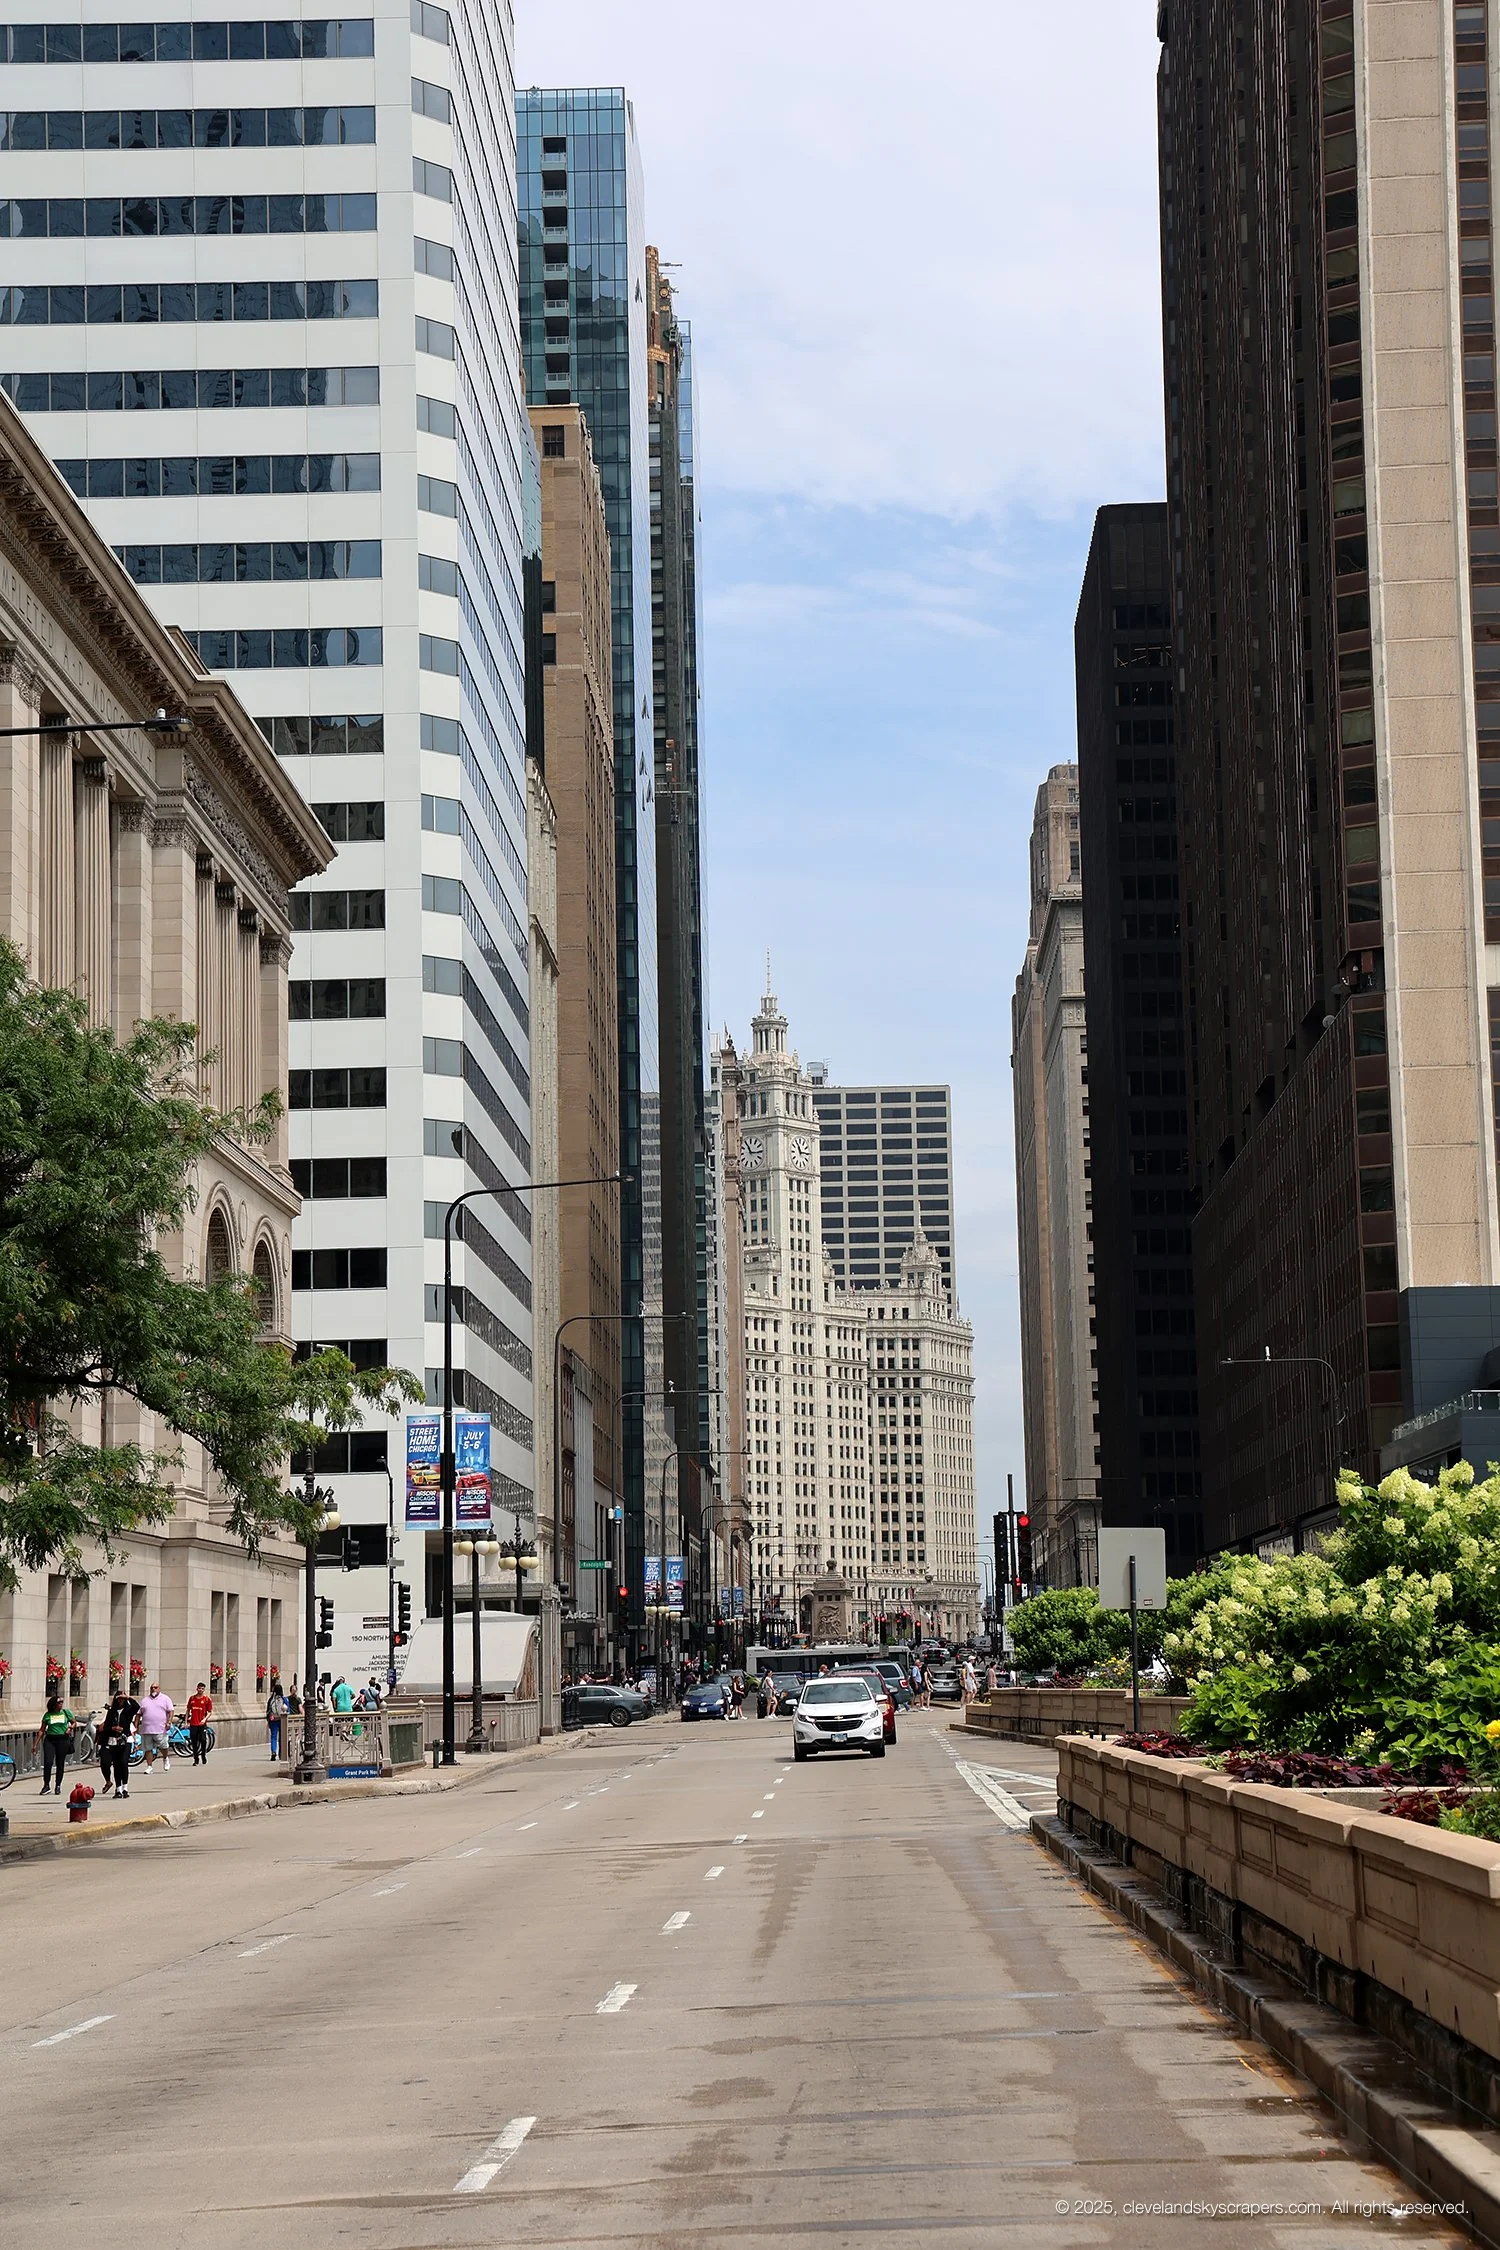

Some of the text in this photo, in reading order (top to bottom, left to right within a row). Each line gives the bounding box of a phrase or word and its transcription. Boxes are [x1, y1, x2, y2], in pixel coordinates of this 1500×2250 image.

[410, 1427, 438, 1436] STREET
[464, 1431, 484, 1440] JULY
[410, 1435, 437, 1445] HOME
[408, 1445, 437, 1453] CHICAGO
[463, 1441, 480, 1449] 5-6
